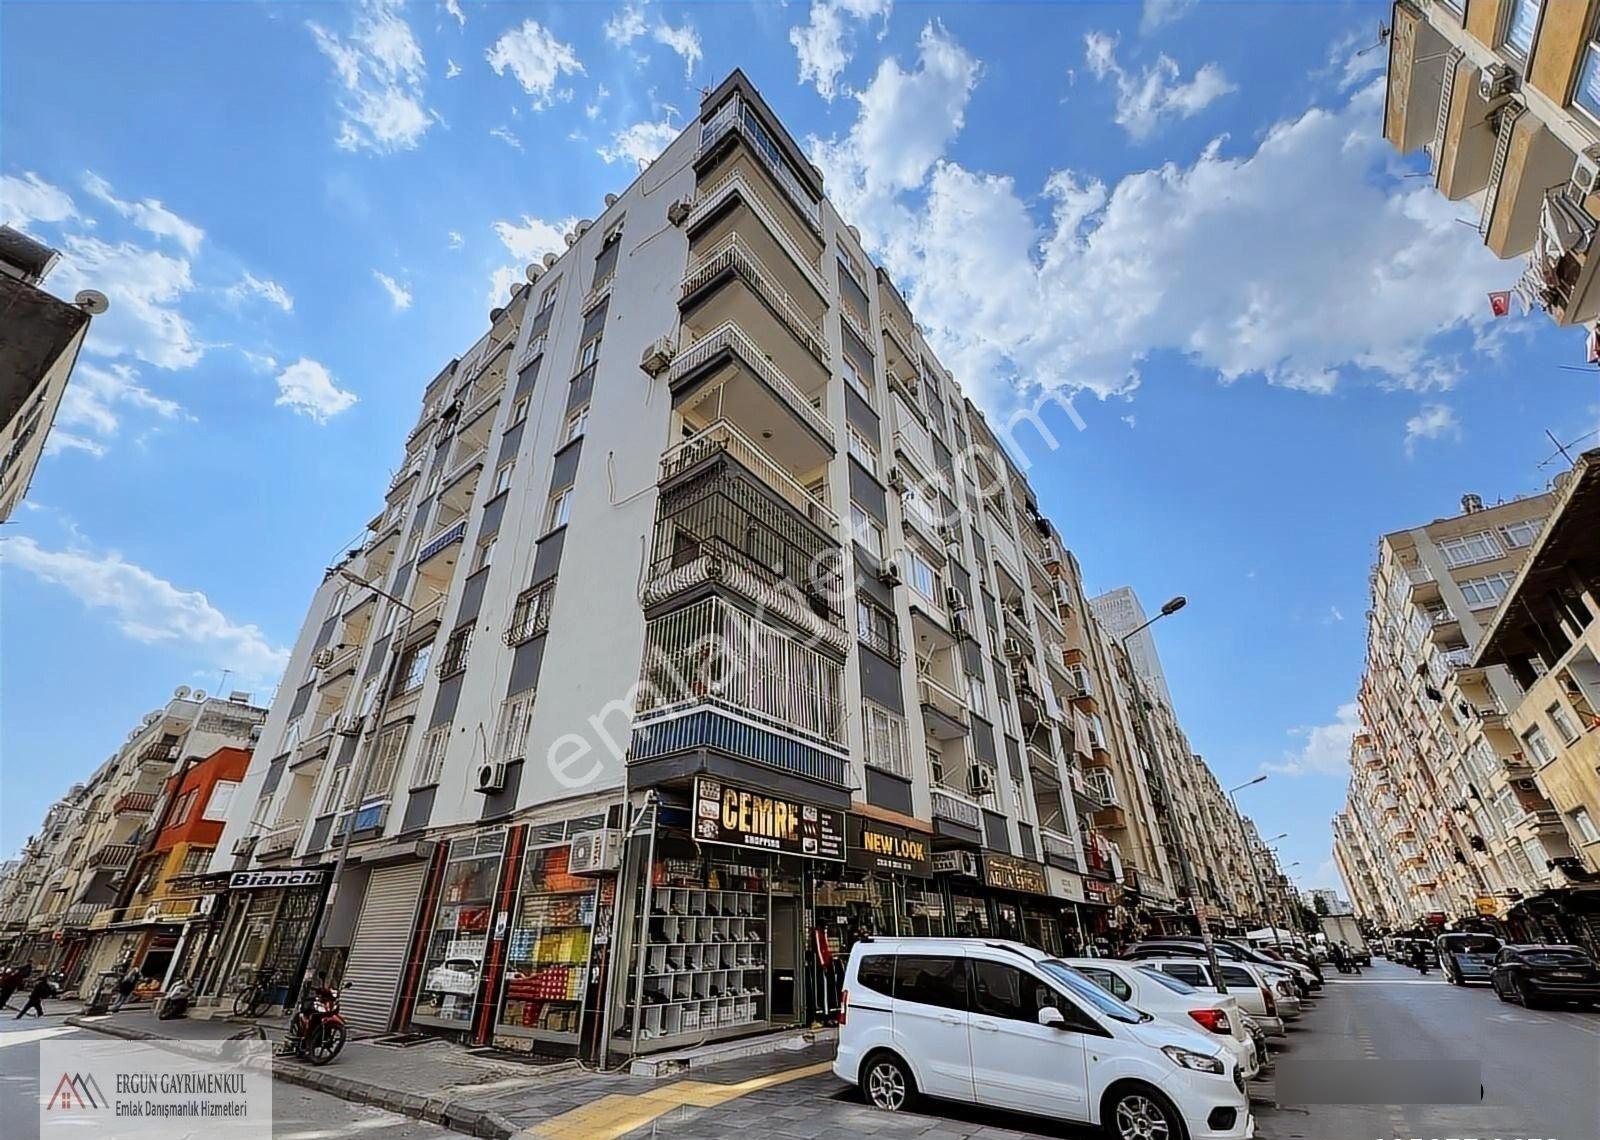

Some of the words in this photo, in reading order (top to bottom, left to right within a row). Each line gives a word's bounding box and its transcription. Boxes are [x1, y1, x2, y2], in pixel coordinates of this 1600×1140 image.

[722, 788, 798, 841] CEMRE
[864, 831, 893, 855] NEW
[895, 837, 925, 861] LOOK
